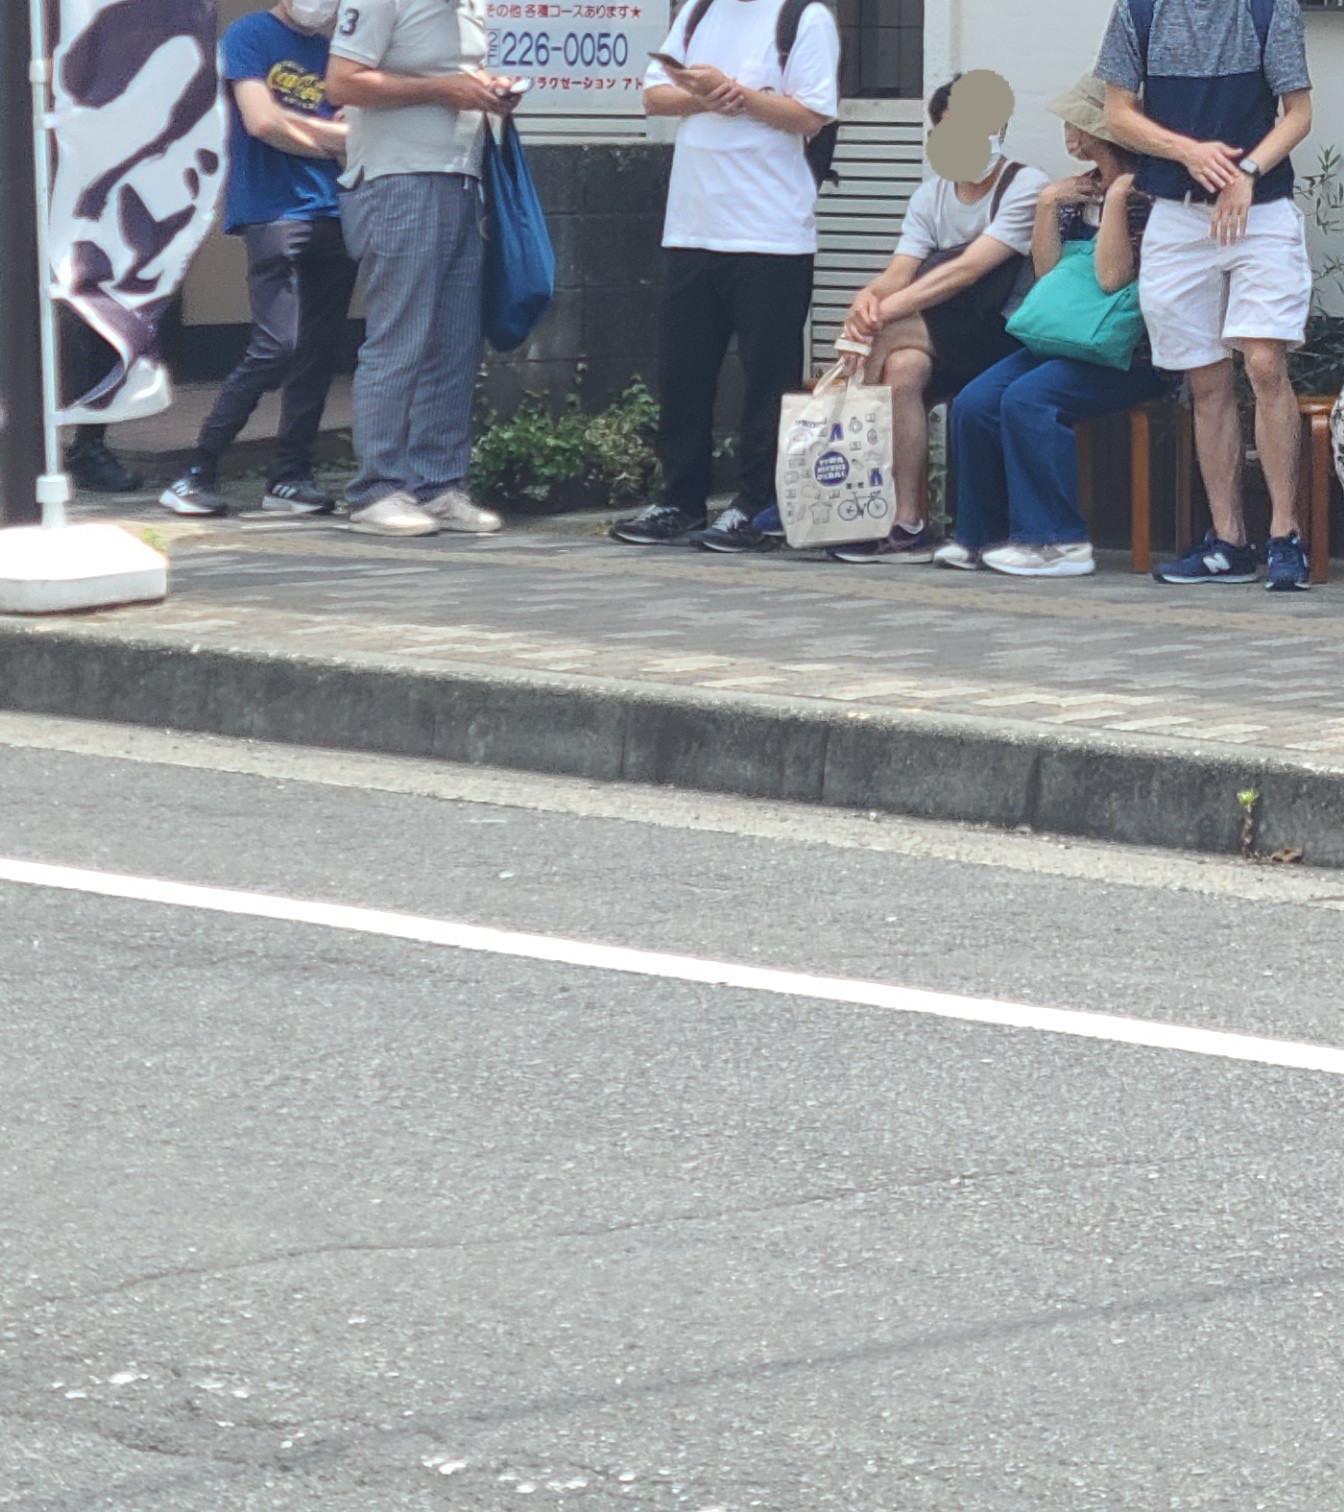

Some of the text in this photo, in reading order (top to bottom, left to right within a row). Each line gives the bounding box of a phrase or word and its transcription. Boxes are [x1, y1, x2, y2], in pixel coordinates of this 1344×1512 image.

[339, 8, 360, 36] 3
[501, 31, 629, 67] 226-0050
[623, 77, 643, 90] アト
